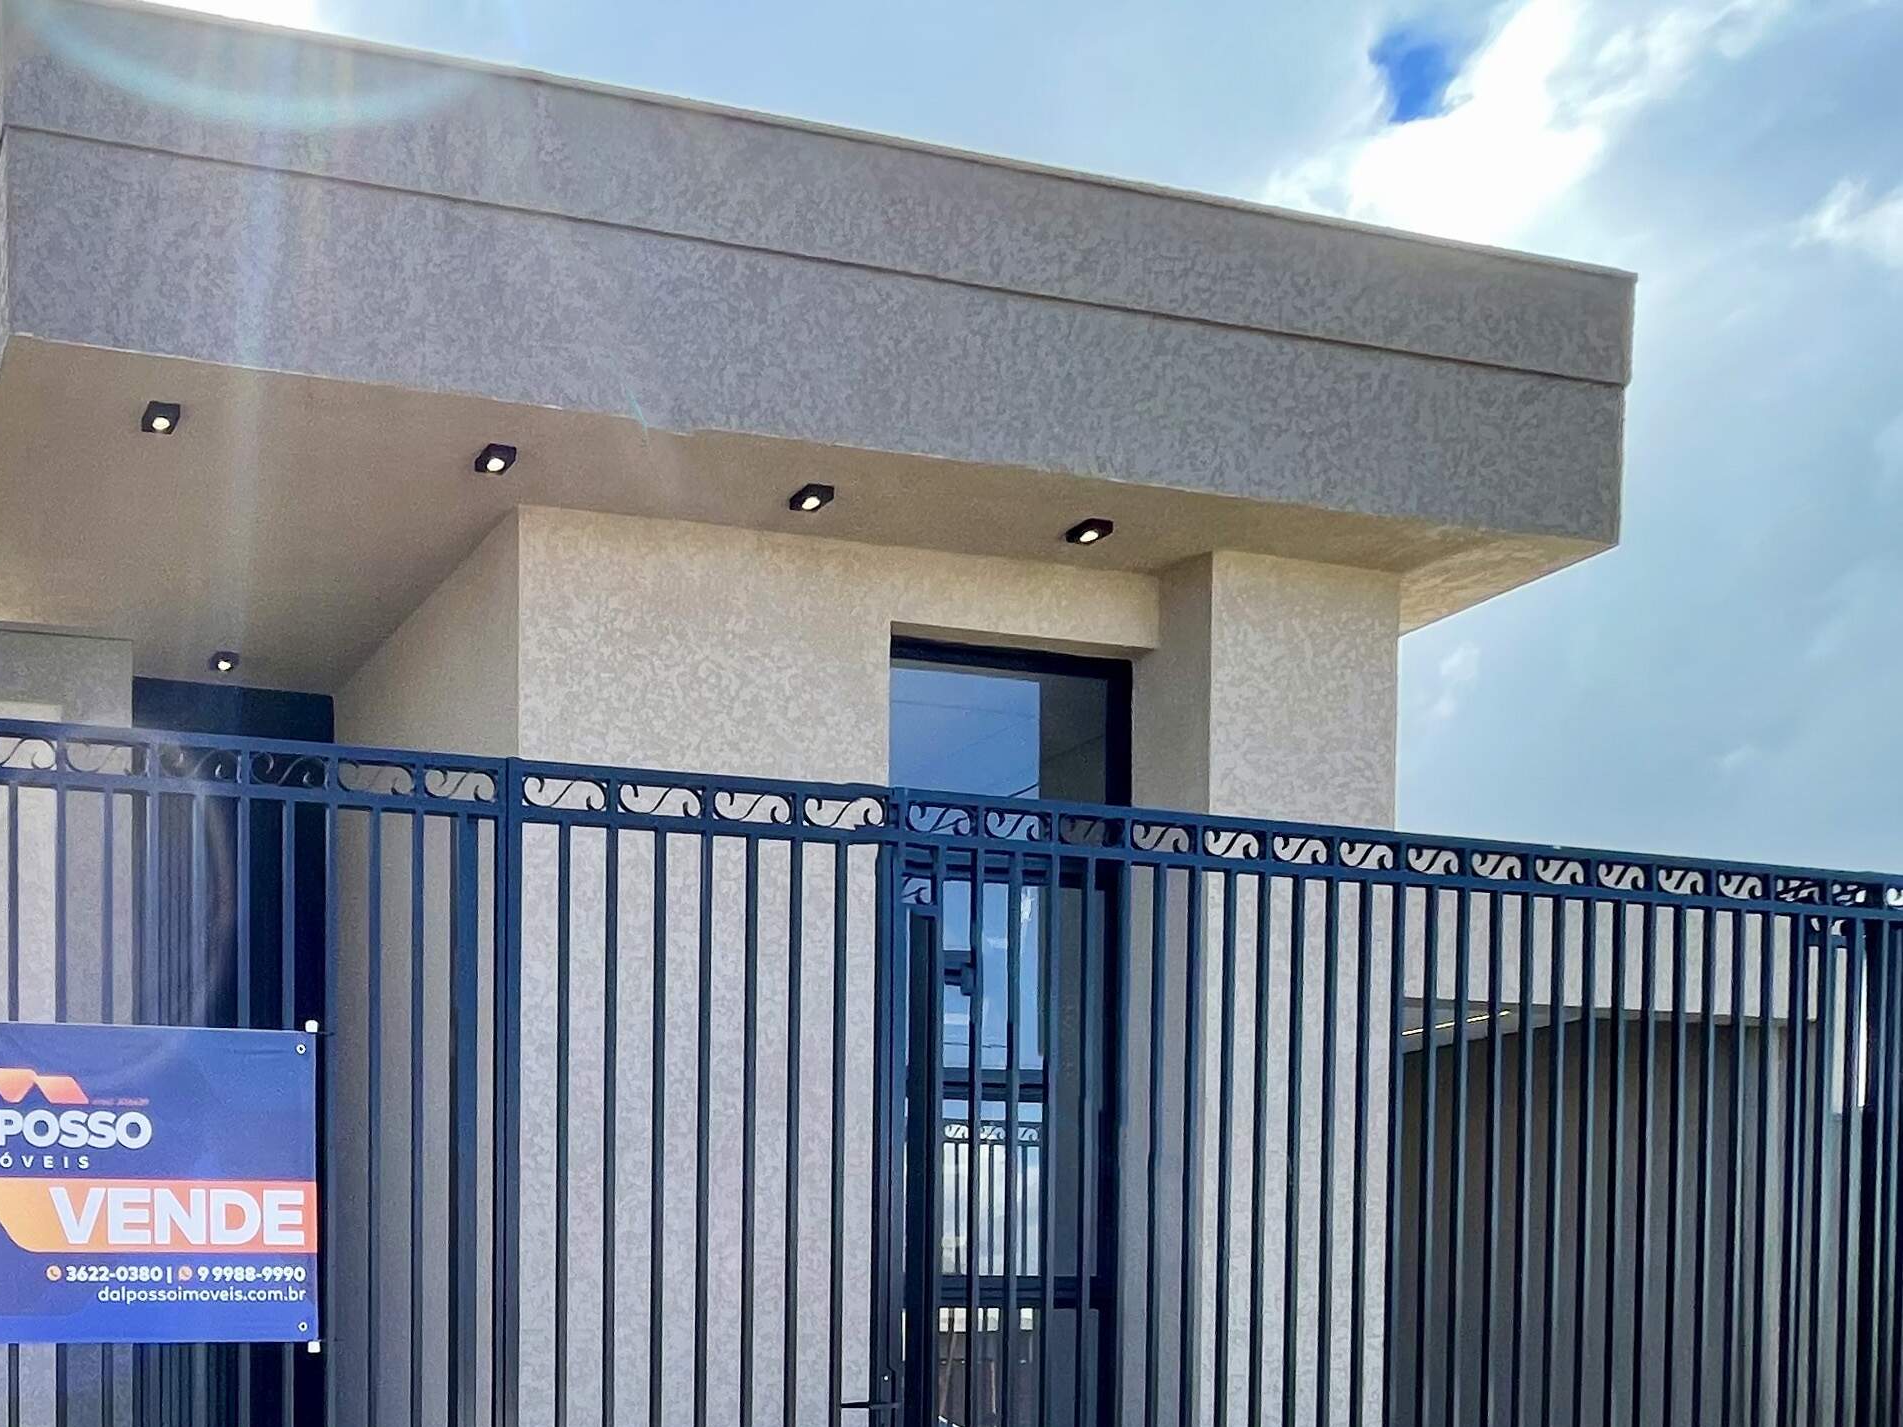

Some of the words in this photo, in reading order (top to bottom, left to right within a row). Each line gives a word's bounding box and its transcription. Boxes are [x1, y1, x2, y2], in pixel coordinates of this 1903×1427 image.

[49, 1186, 305, 1246] VENDE
[66, 1266, 162, 1282] 3622-0380
[97, 1286, 306, 1305] dalpossoimoveis.com.br
